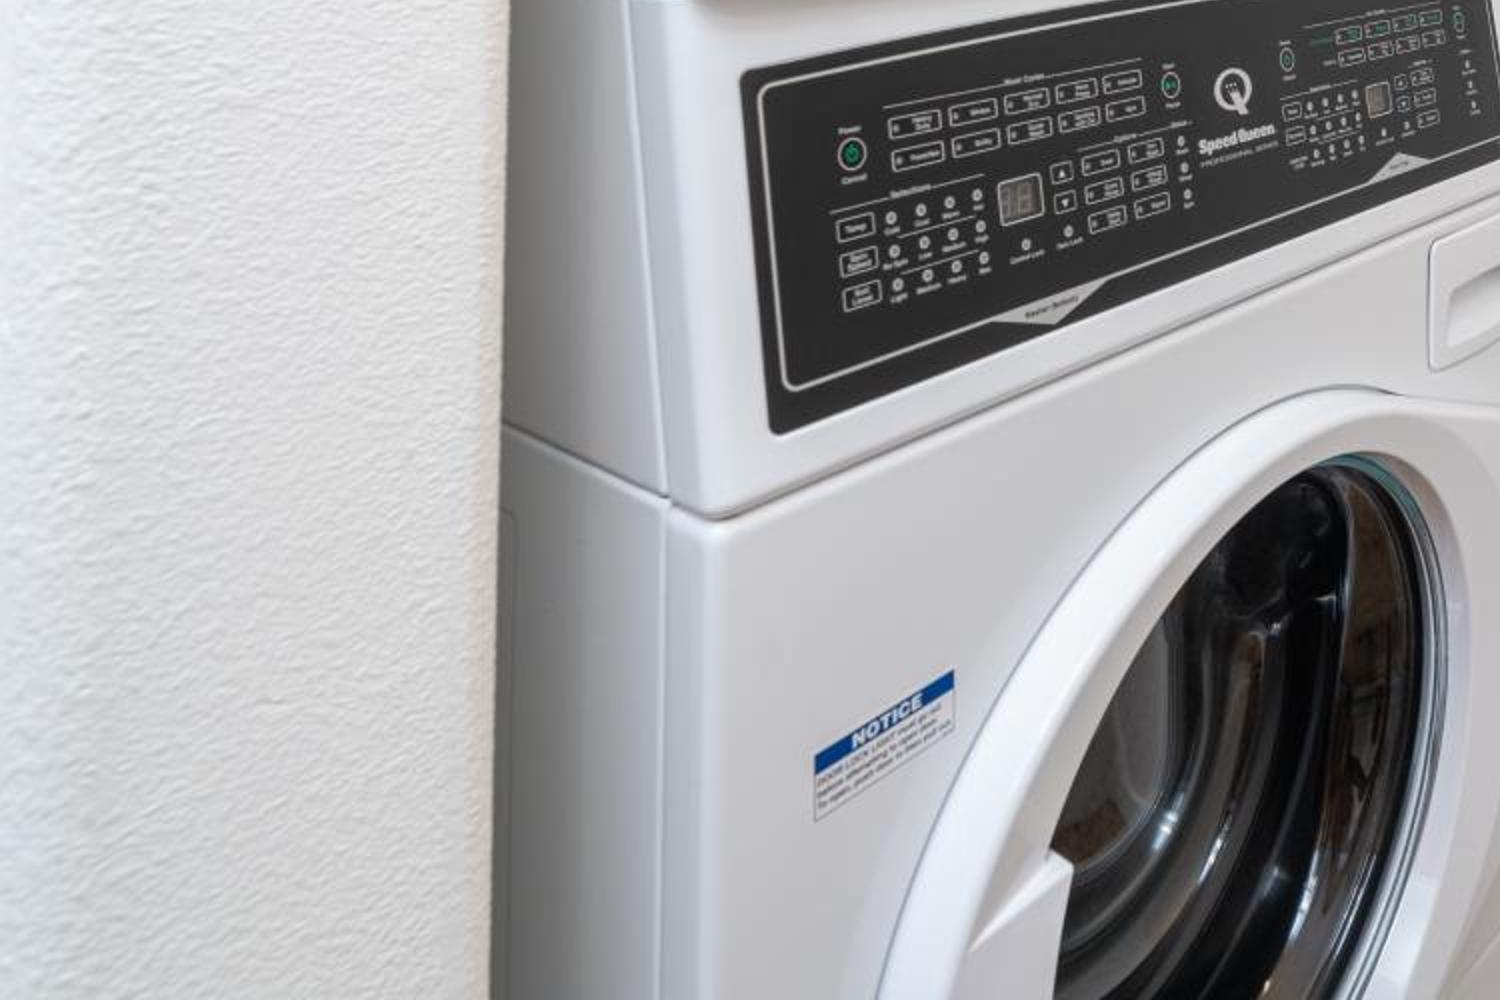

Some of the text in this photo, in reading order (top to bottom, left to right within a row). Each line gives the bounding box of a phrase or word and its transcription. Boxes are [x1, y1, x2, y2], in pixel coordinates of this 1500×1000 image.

[1198, 123, 1276, 156] Speed Queen
[851, 692, 925, 749] NOTICE
